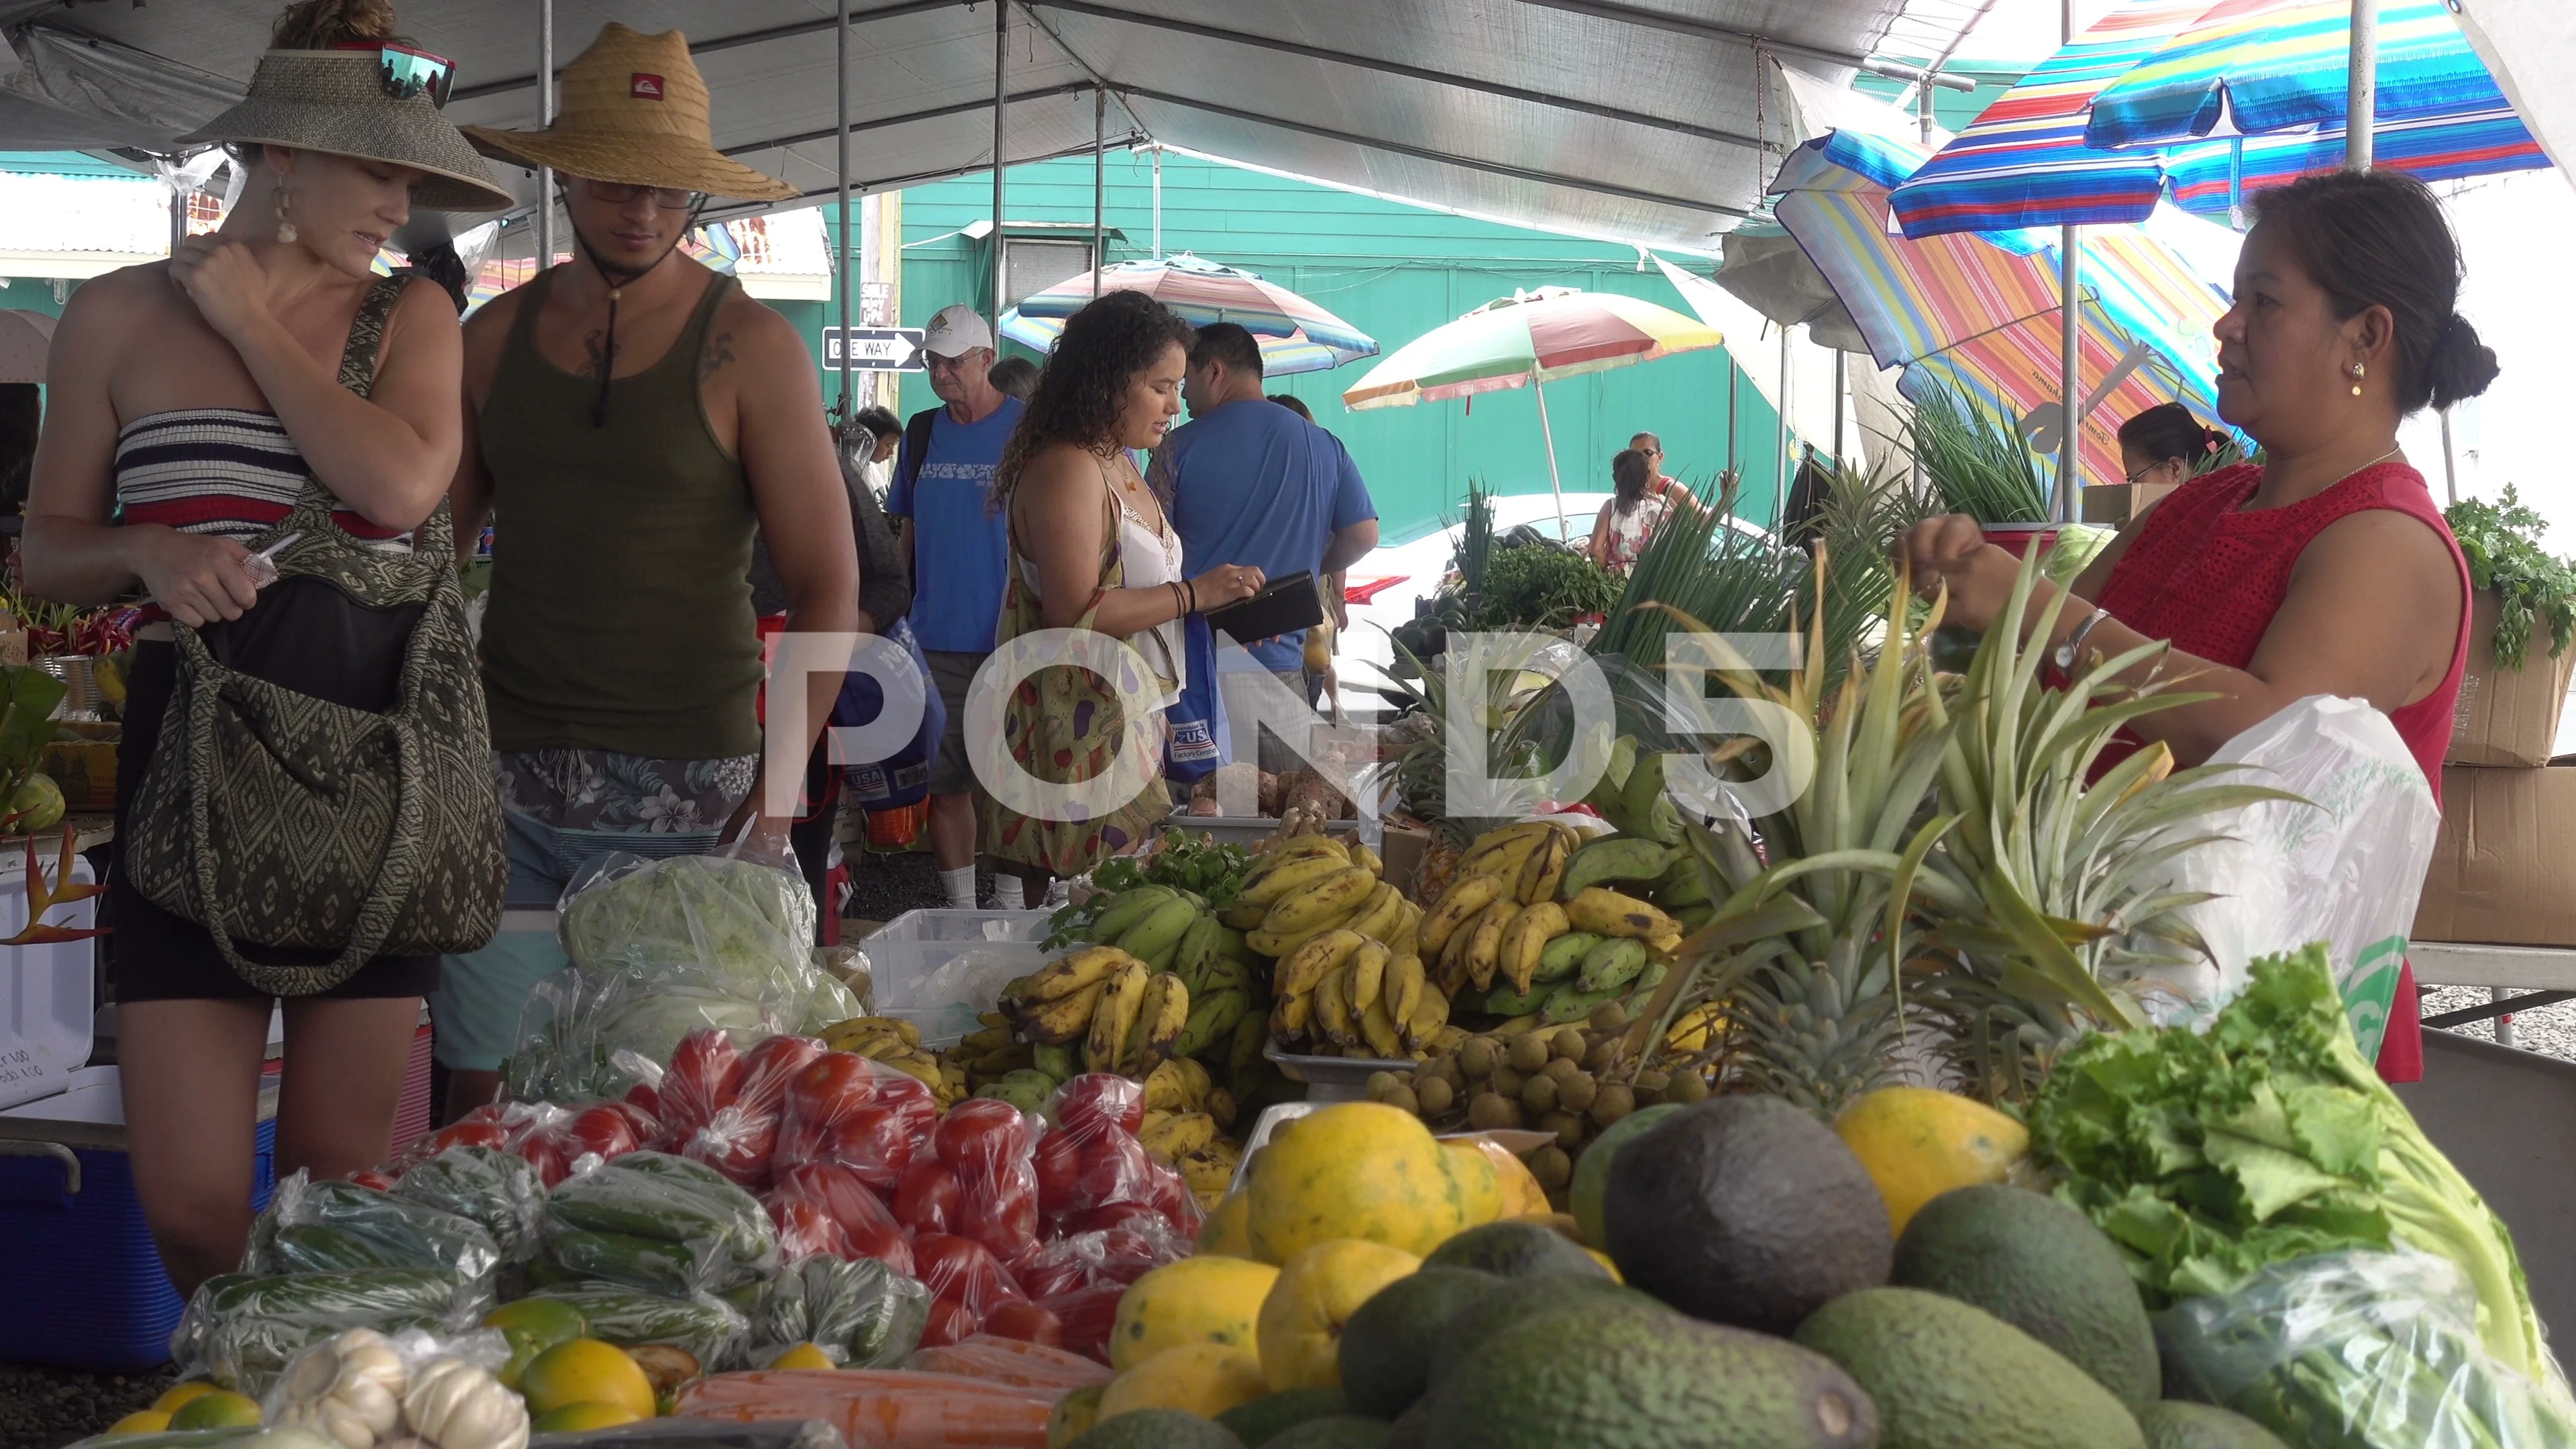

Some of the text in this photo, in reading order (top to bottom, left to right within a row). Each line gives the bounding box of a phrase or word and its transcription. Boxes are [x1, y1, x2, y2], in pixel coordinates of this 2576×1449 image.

[833, 341, 892, 356] OE WAY
[1175, 751, 1195, 759] Factory
[1196, 748, 1217, 756] Certifie
[1338, 743, 1385, 761] Dole
[851, 770, 881, 786] USA
